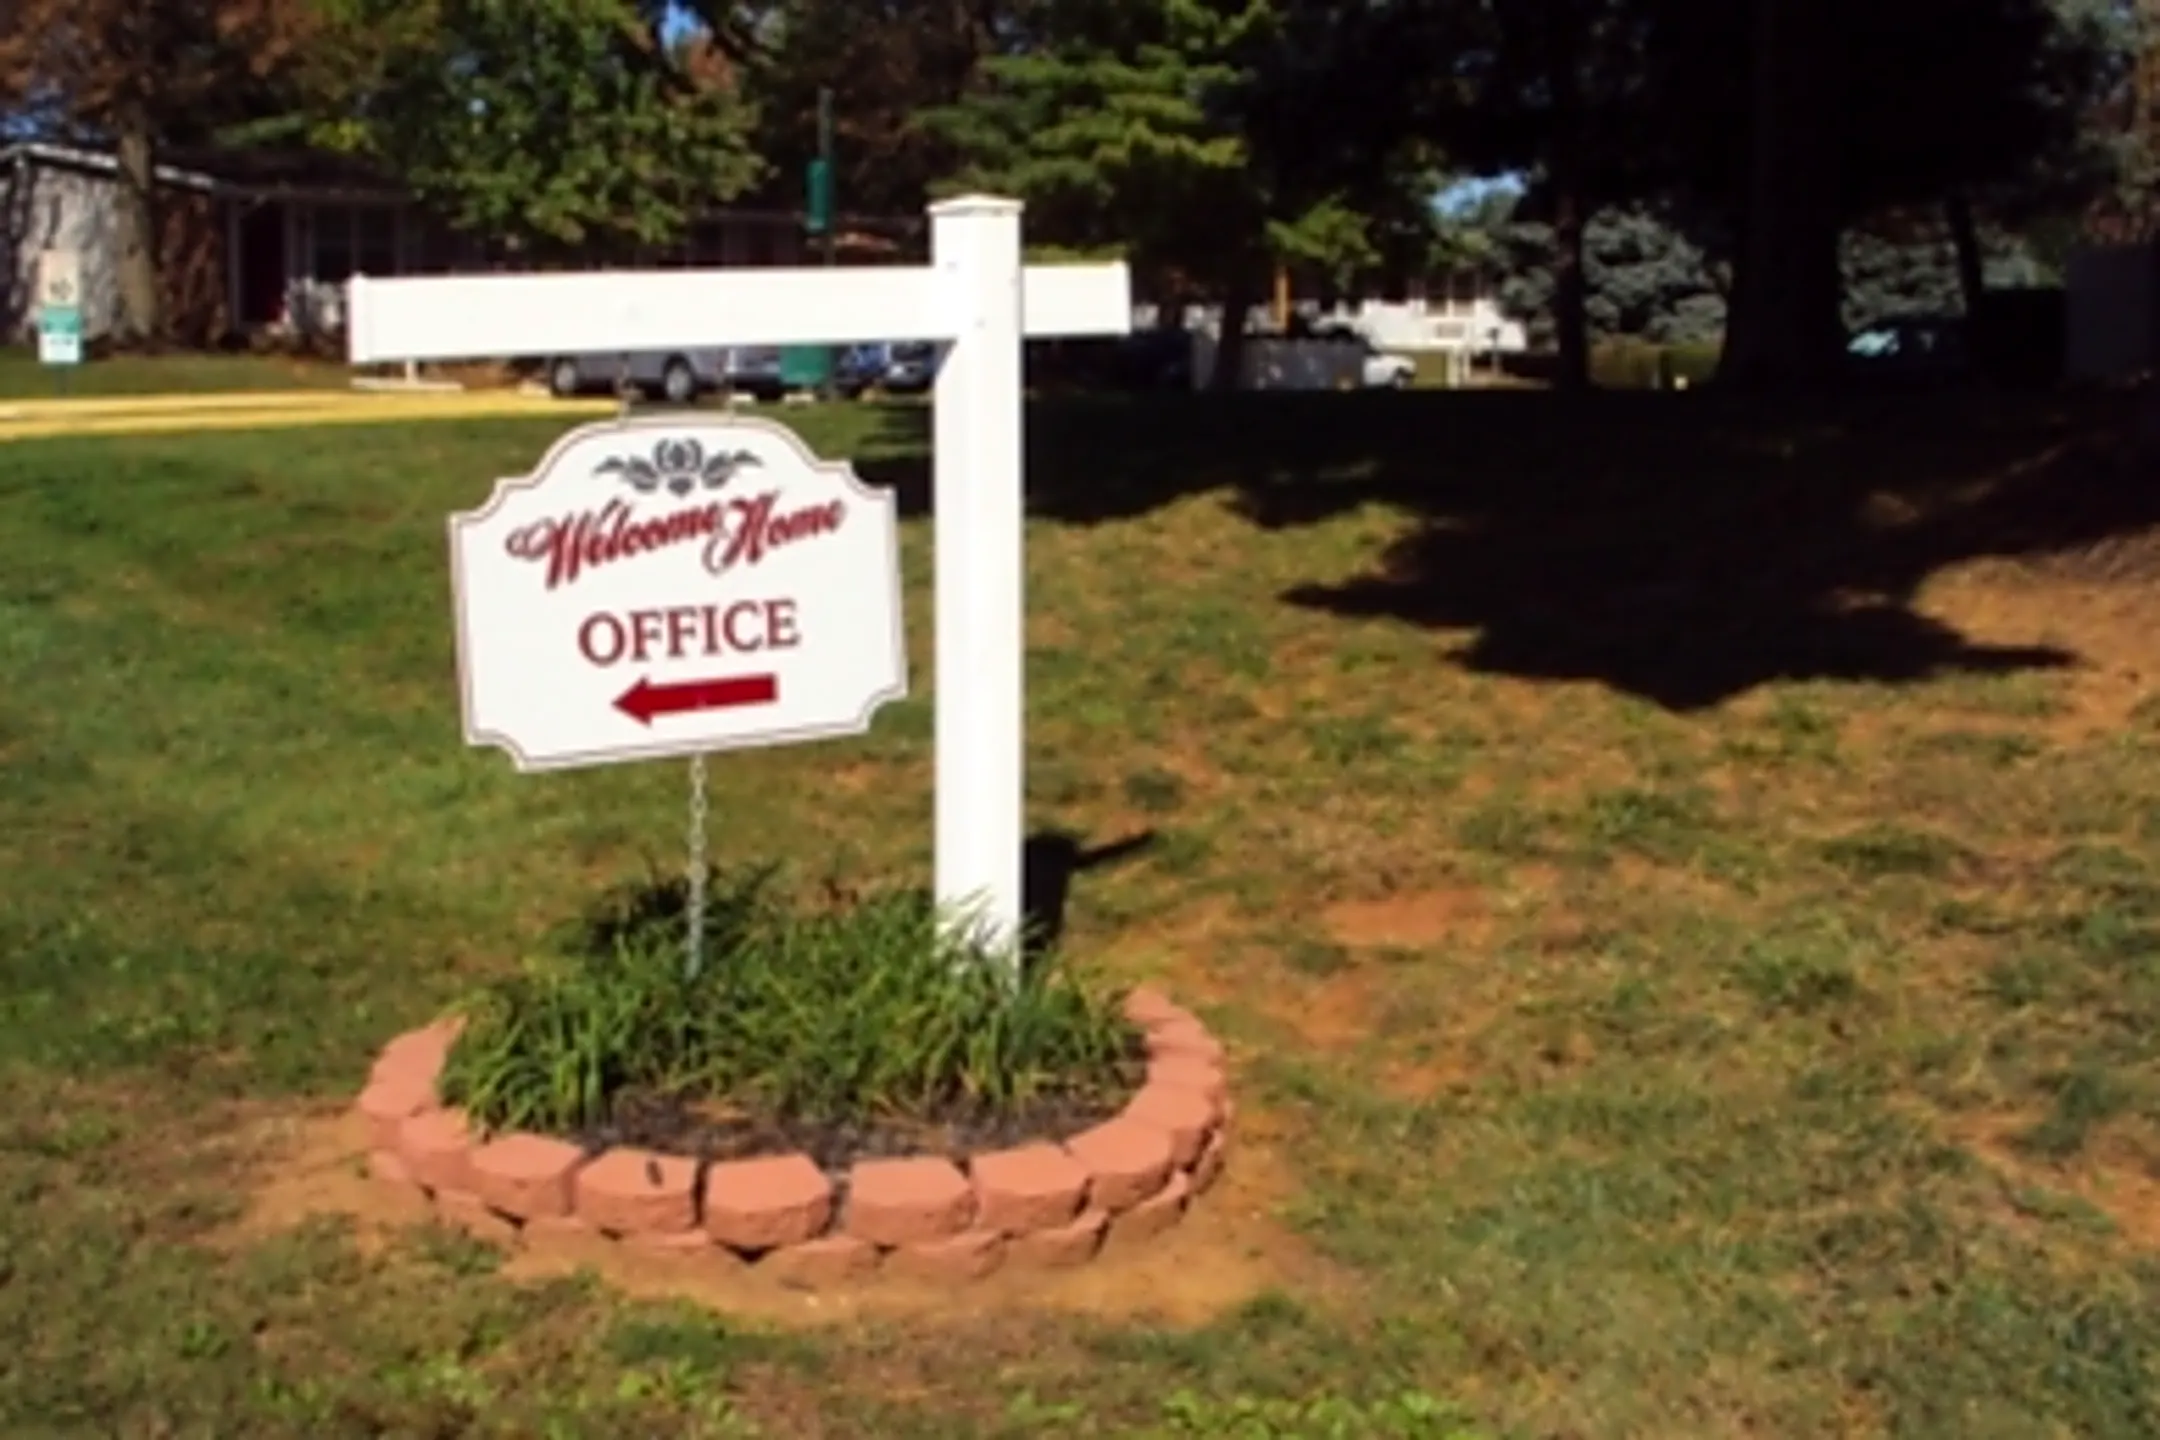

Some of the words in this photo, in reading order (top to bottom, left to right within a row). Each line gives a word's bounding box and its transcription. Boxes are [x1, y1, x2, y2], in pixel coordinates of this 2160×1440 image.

[505, 498, 723, 590] Welcome
[702, 491, 846, 575] Home
[578, 599, 800, 668] OFFICE
